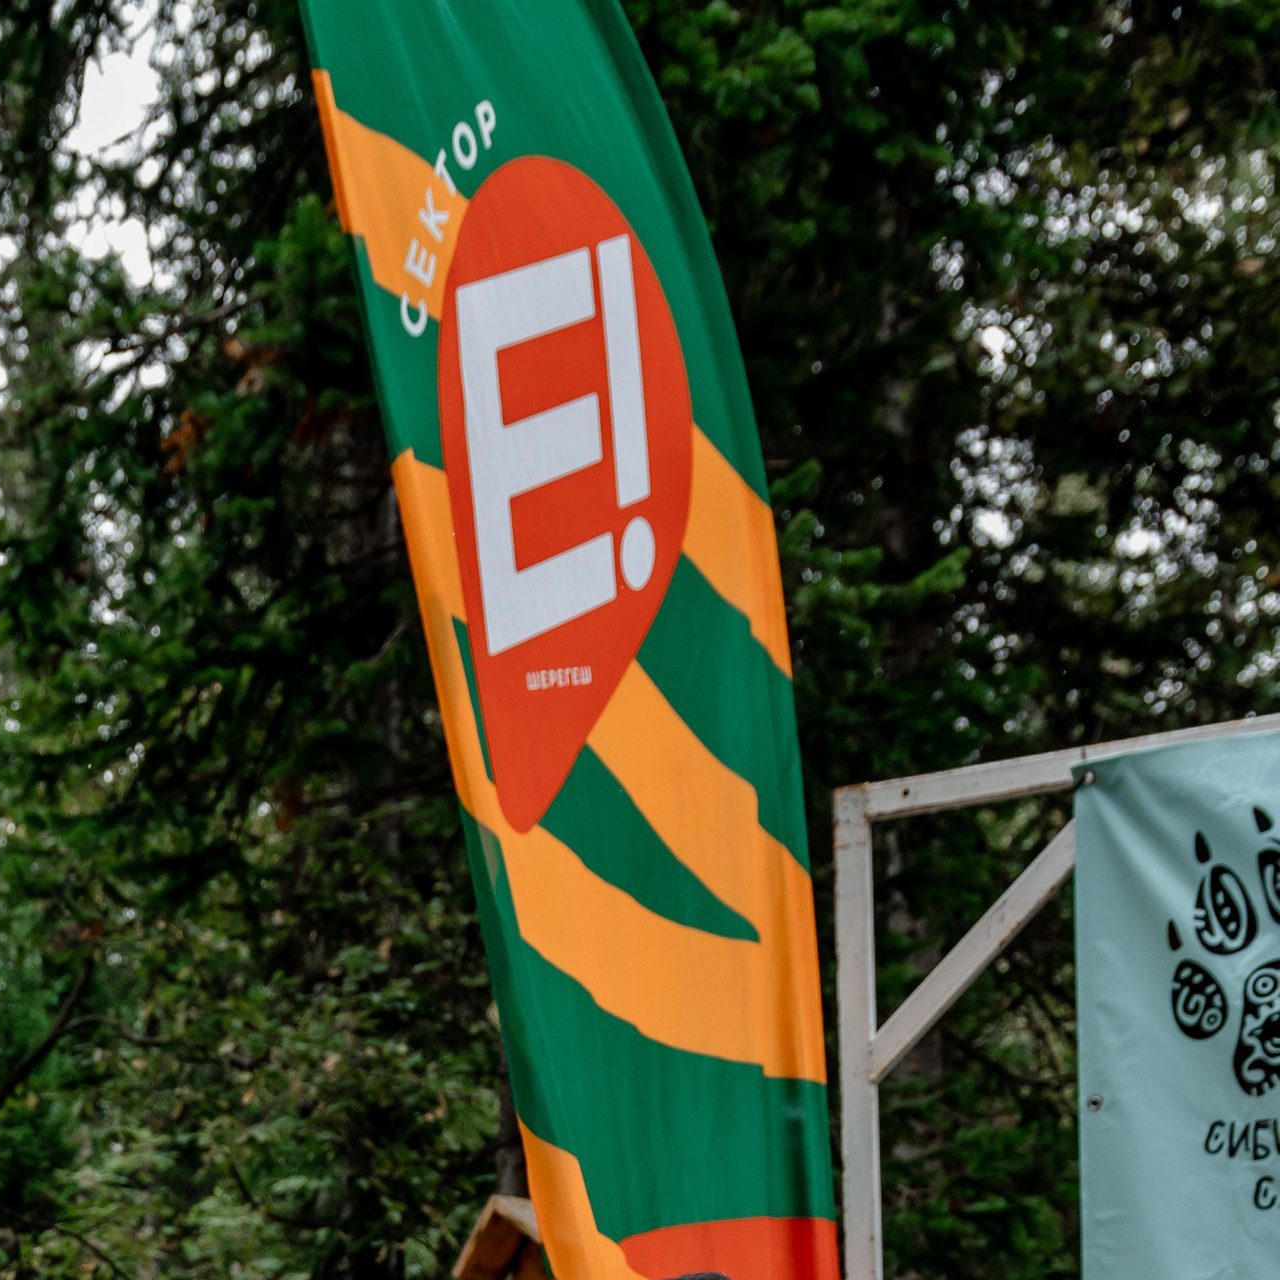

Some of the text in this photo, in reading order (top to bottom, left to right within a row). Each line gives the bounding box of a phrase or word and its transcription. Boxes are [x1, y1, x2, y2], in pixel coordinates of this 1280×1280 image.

[399, 98, 498, 338] СЕКТОР
[454, 232, 657, 657] Е!
[526, 666, 593, 691] ШЕРЕГЕШ
[1204, 1118, 1280, 1161] СИБ
